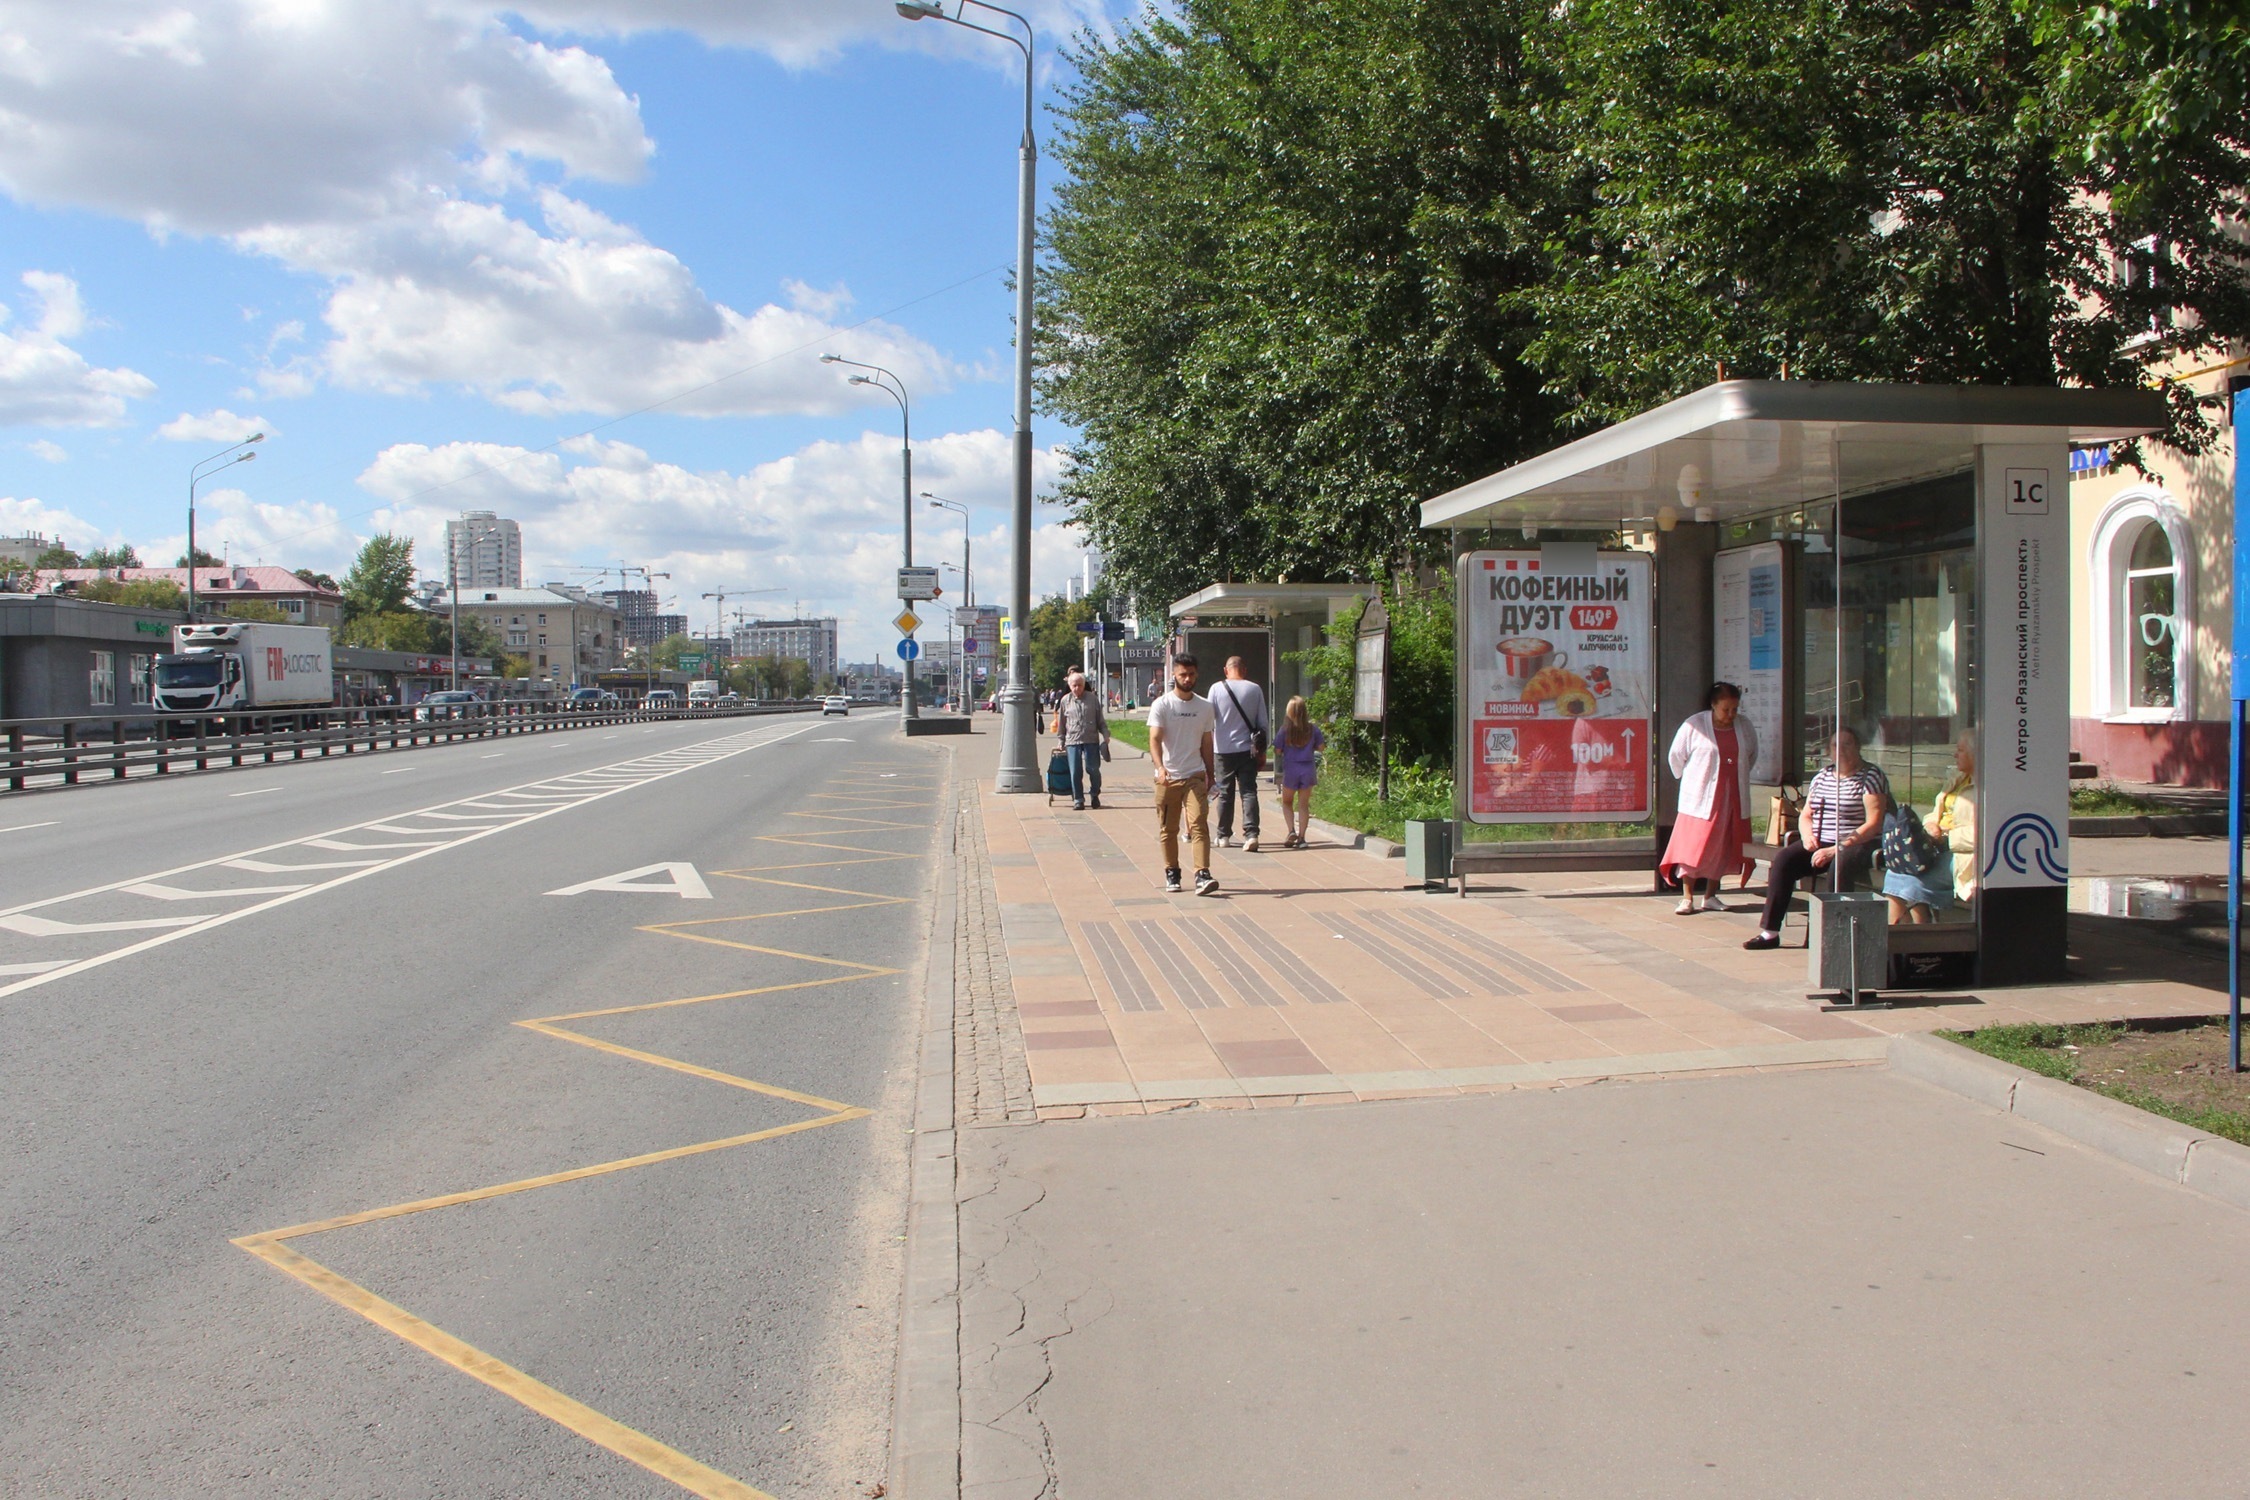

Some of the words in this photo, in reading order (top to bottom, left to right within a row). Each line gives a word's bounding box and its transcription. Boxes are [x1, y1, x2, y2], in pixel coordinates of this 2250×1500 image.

[2018, 539, 2030, 618] проспект»
[2032, 539, 2041, 584] Prospekt
[1500, 605, 1564, 635] ДУЭТ
[2032, 587, 2041, 645] Ryazanskiy
[267, 647, 284, 681] FM
[288, 654, 322, 674] LOGISTIC
[1120, 649, 1160, 660] ЦВЕТЫ
[1578, 643, 1616, 651] КАПУЧИНО
[2032, 646, 2040, 679] Metro
[2015, 623, 2028, 714] «Рязанский
[1489, 703, 1535, 714] НОВИНКА
[2015, 718, 2029, 772] Метро
